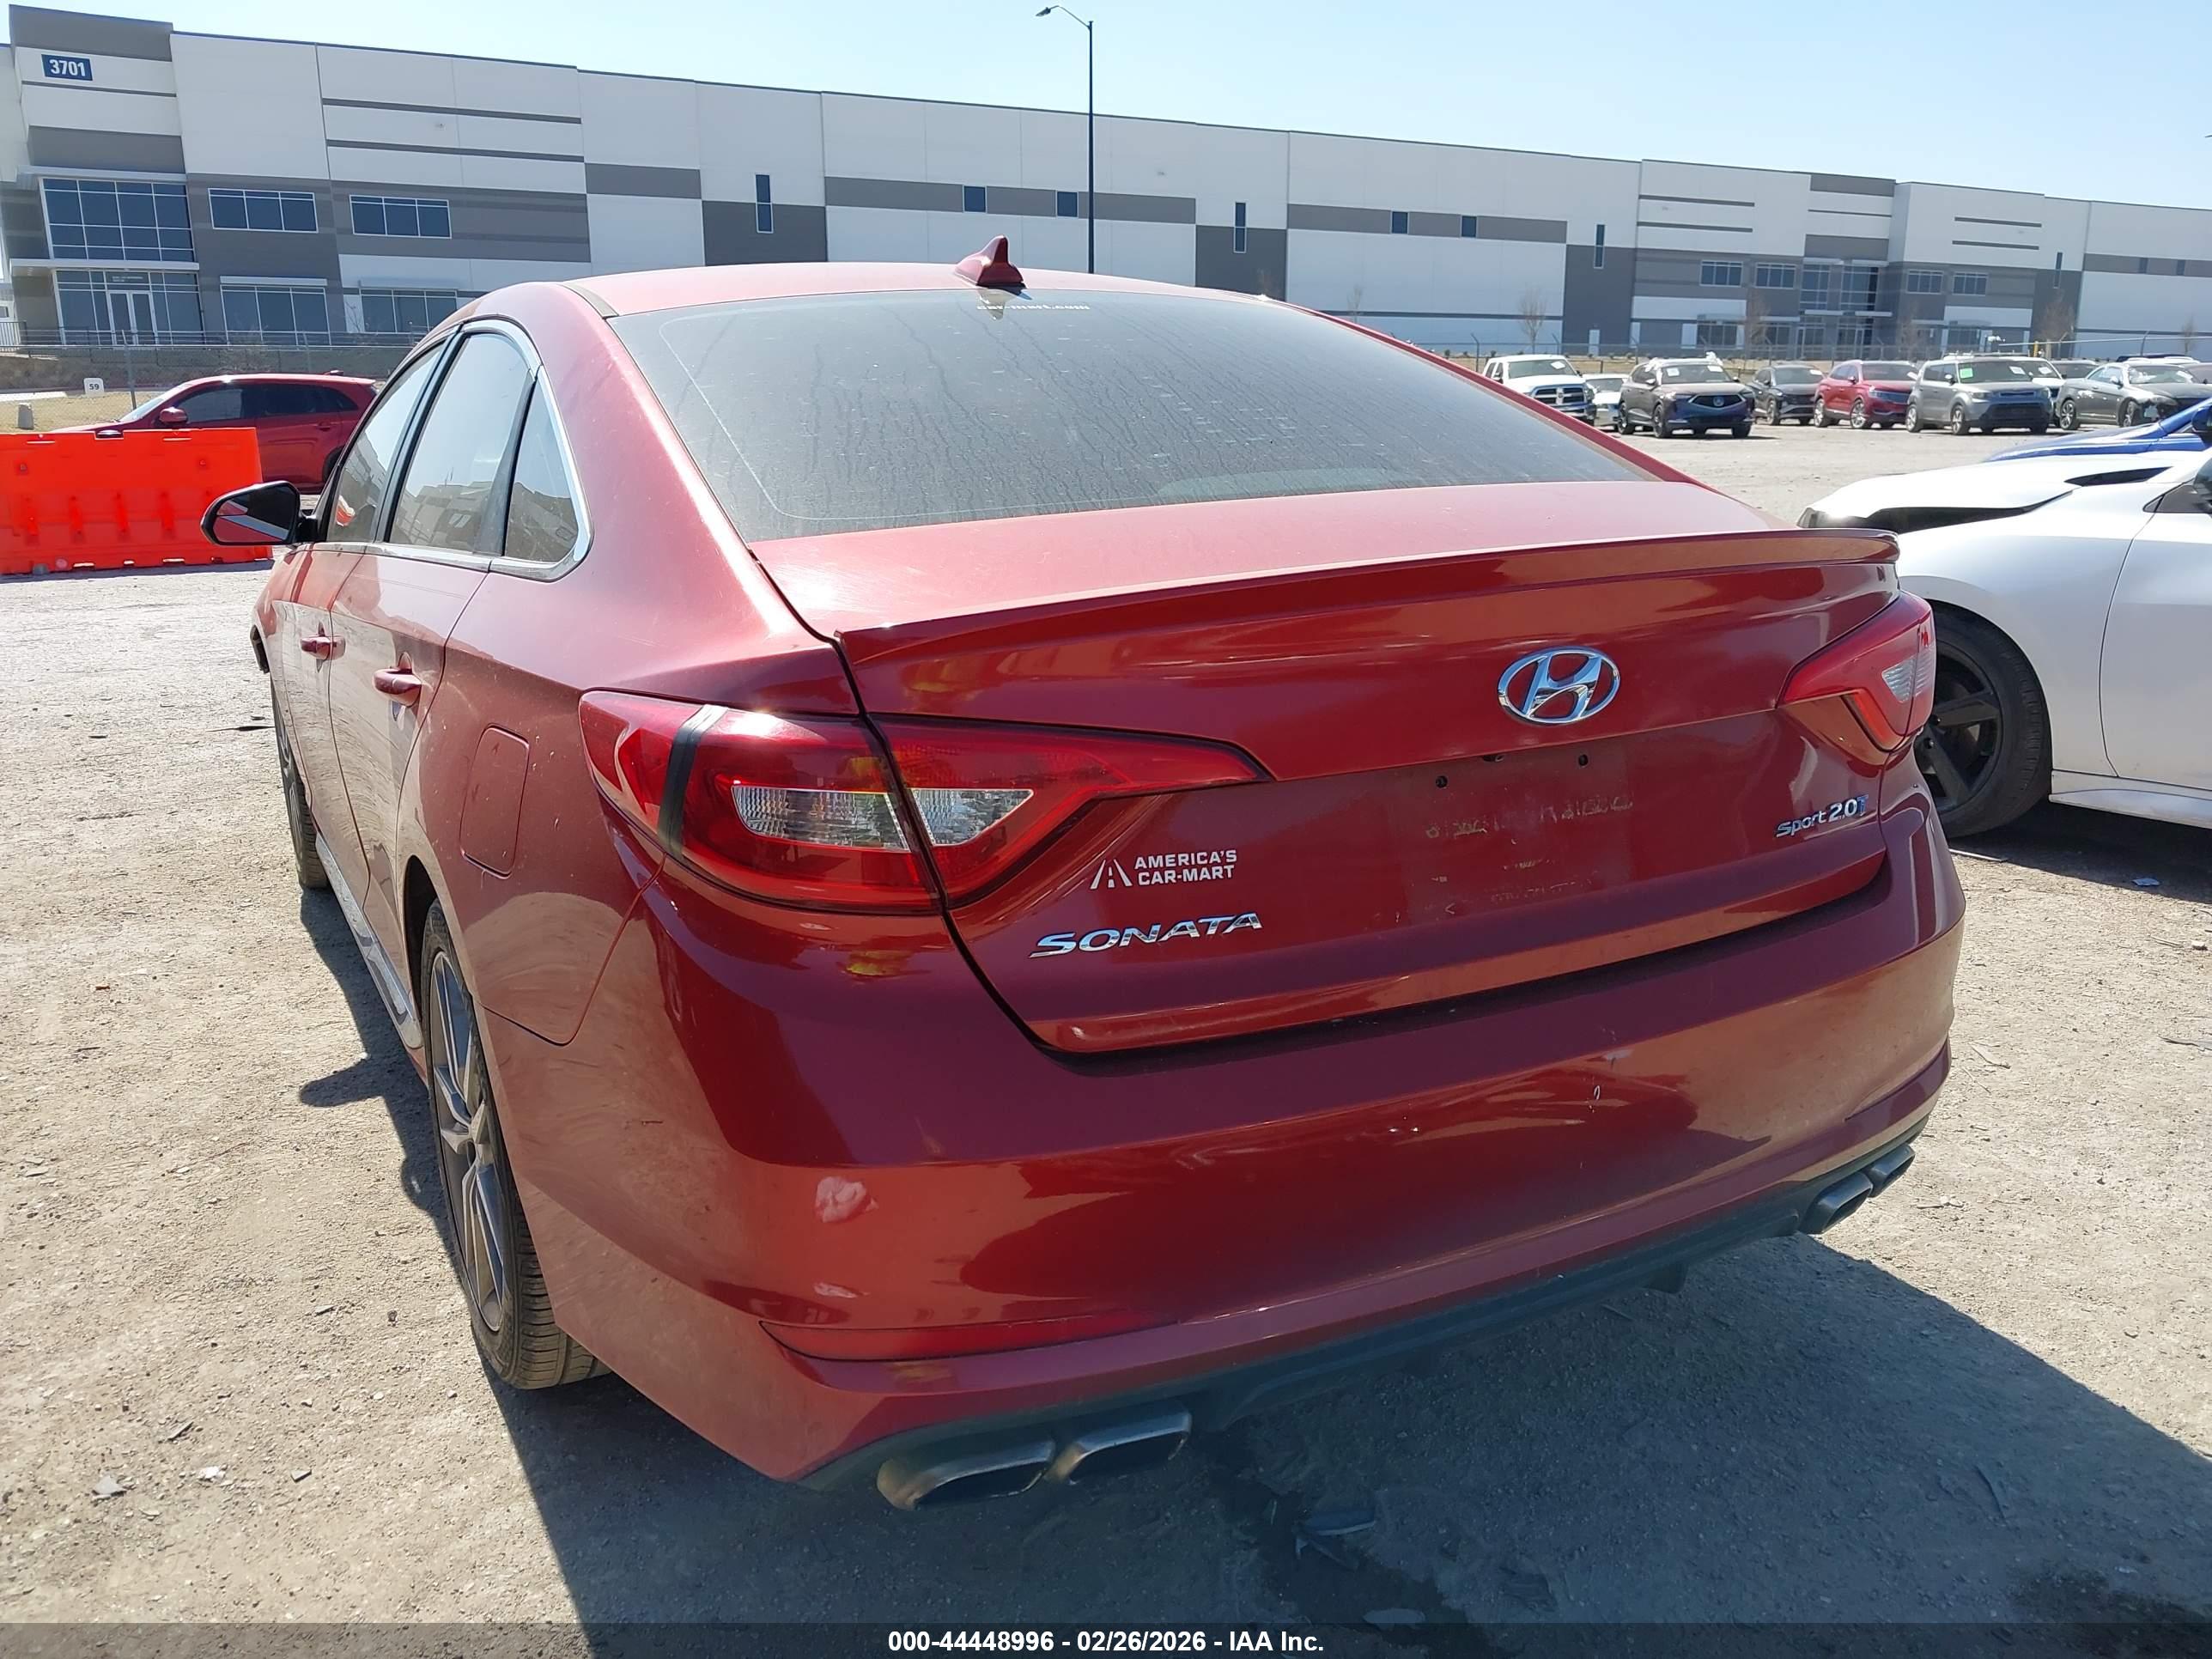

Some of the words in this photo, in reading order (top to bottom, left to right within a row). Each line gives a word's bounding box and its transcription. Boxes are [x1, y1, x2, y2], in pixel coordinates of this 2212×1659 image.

[49, 59, 86, 76] 3701
[1776, 810, 1827, 838] Sport
[1134, 849, 1237, 870] AMERICA'S
[1138, 865, 1235, 886] CAR-MART
[1030, 912, 1264, 958] SONATA
